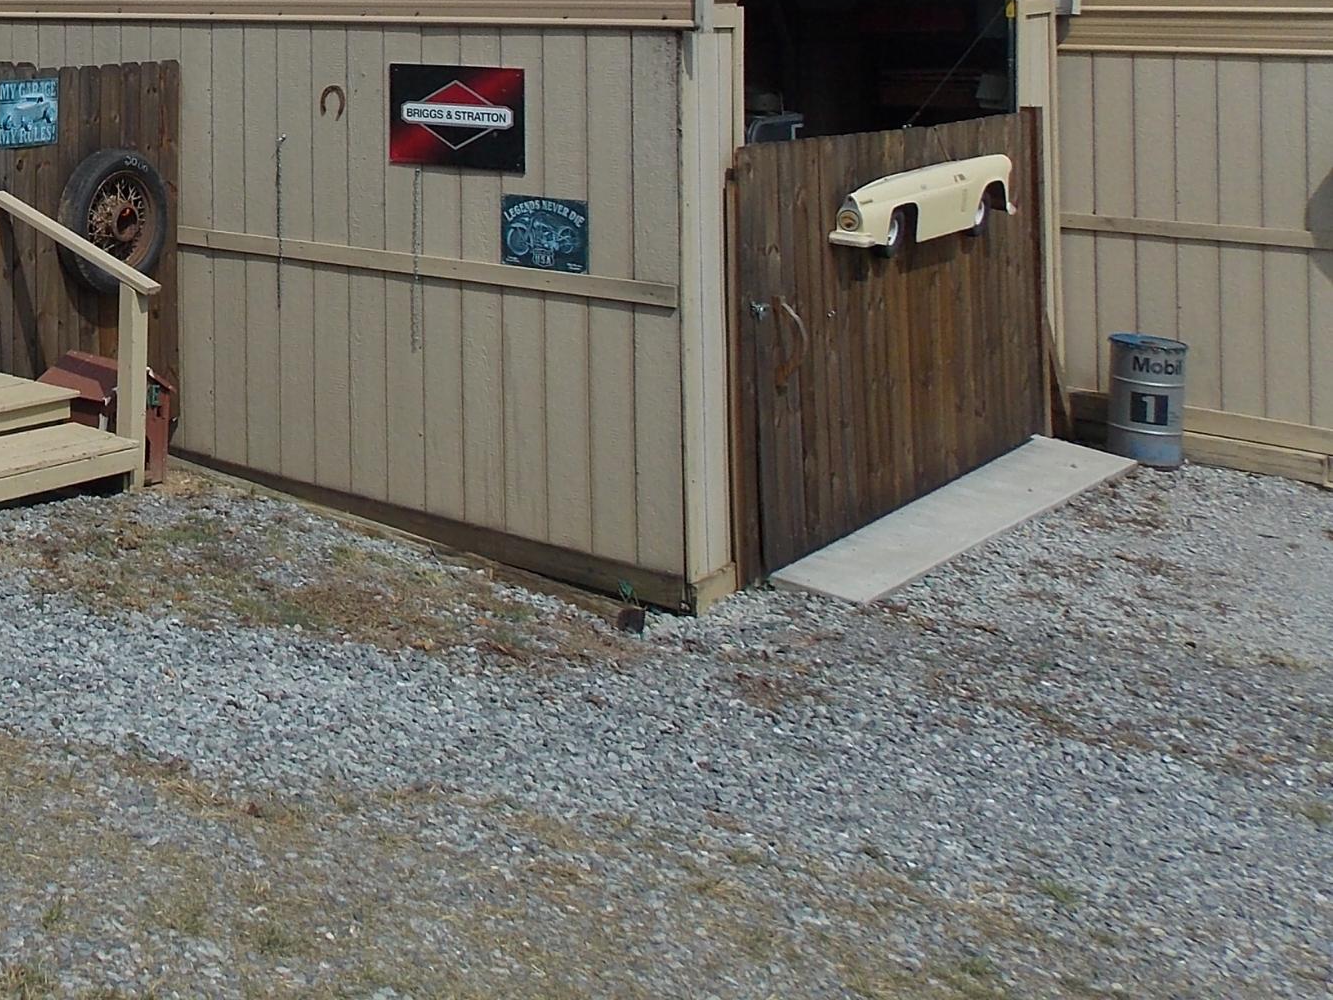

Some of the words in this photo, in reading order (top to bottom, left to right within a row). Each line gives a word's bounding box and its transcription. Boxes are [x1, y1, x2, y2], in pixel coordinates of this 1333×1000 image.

[0, 83, 16, 100] MY
[19, 81, 57, 98] GARAGE
[406, 108, 444, 119] BRIGGS
[446, 111, 453, 120] &
[455, 110, 507, 123] STRATTON
[0, 128, 16, 145] MY
[19, 125, 56, 144] RULES!
[503, 200, 541, 221] LEGENDS
[541, 200, 570, 217] NEVER
[568, 211, 585, 228] DIE
[1132, 356, 1183, 376] Mobil
[1141, 395, 1156, 423] 1
